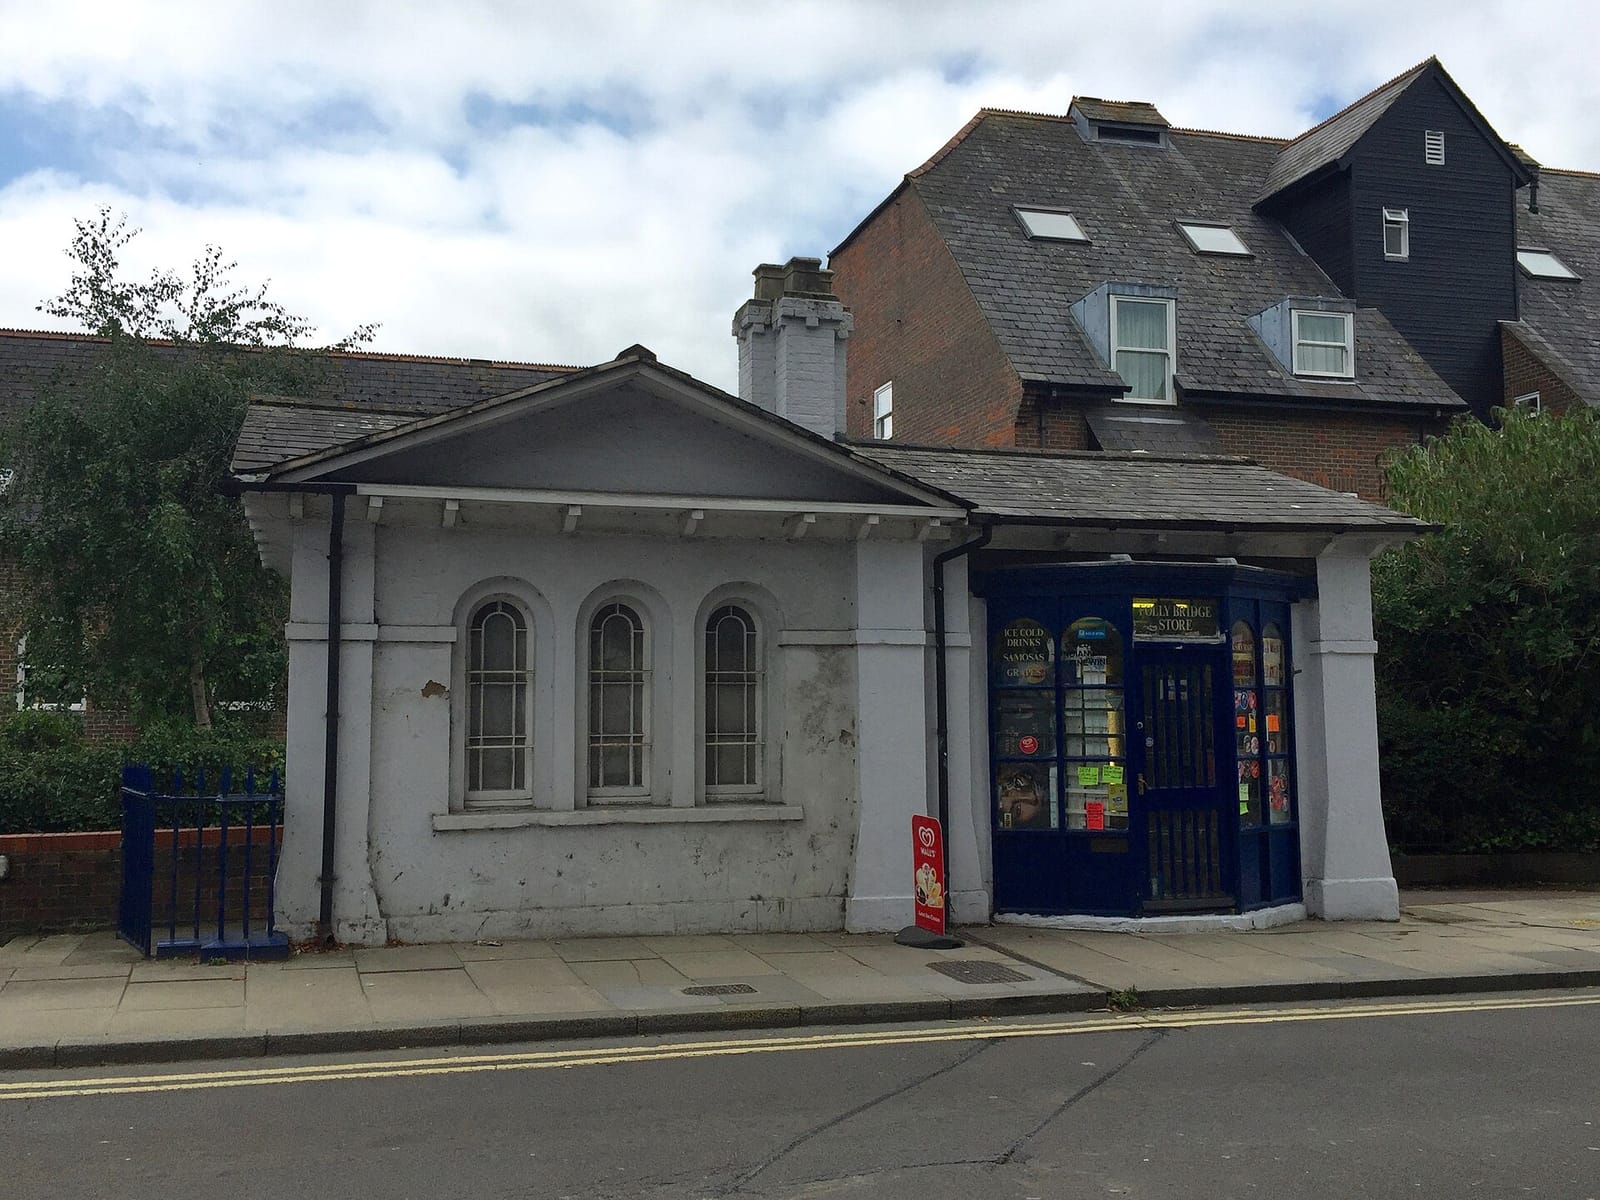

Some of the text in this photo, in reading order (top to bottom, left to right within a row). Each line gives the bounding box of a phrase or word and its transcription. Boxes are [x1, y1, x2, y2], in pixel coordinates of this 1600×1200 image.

[1139, 605, 1212, 617] FOLLY BRIDGE
[1159, 619, 1193, 631] STORE
[1005, 628, 1044, 637] ICE COLD
[1008, 638, 1041, 647] DRINKS
[1003, 653, 1045, 662] SAMOSAS
